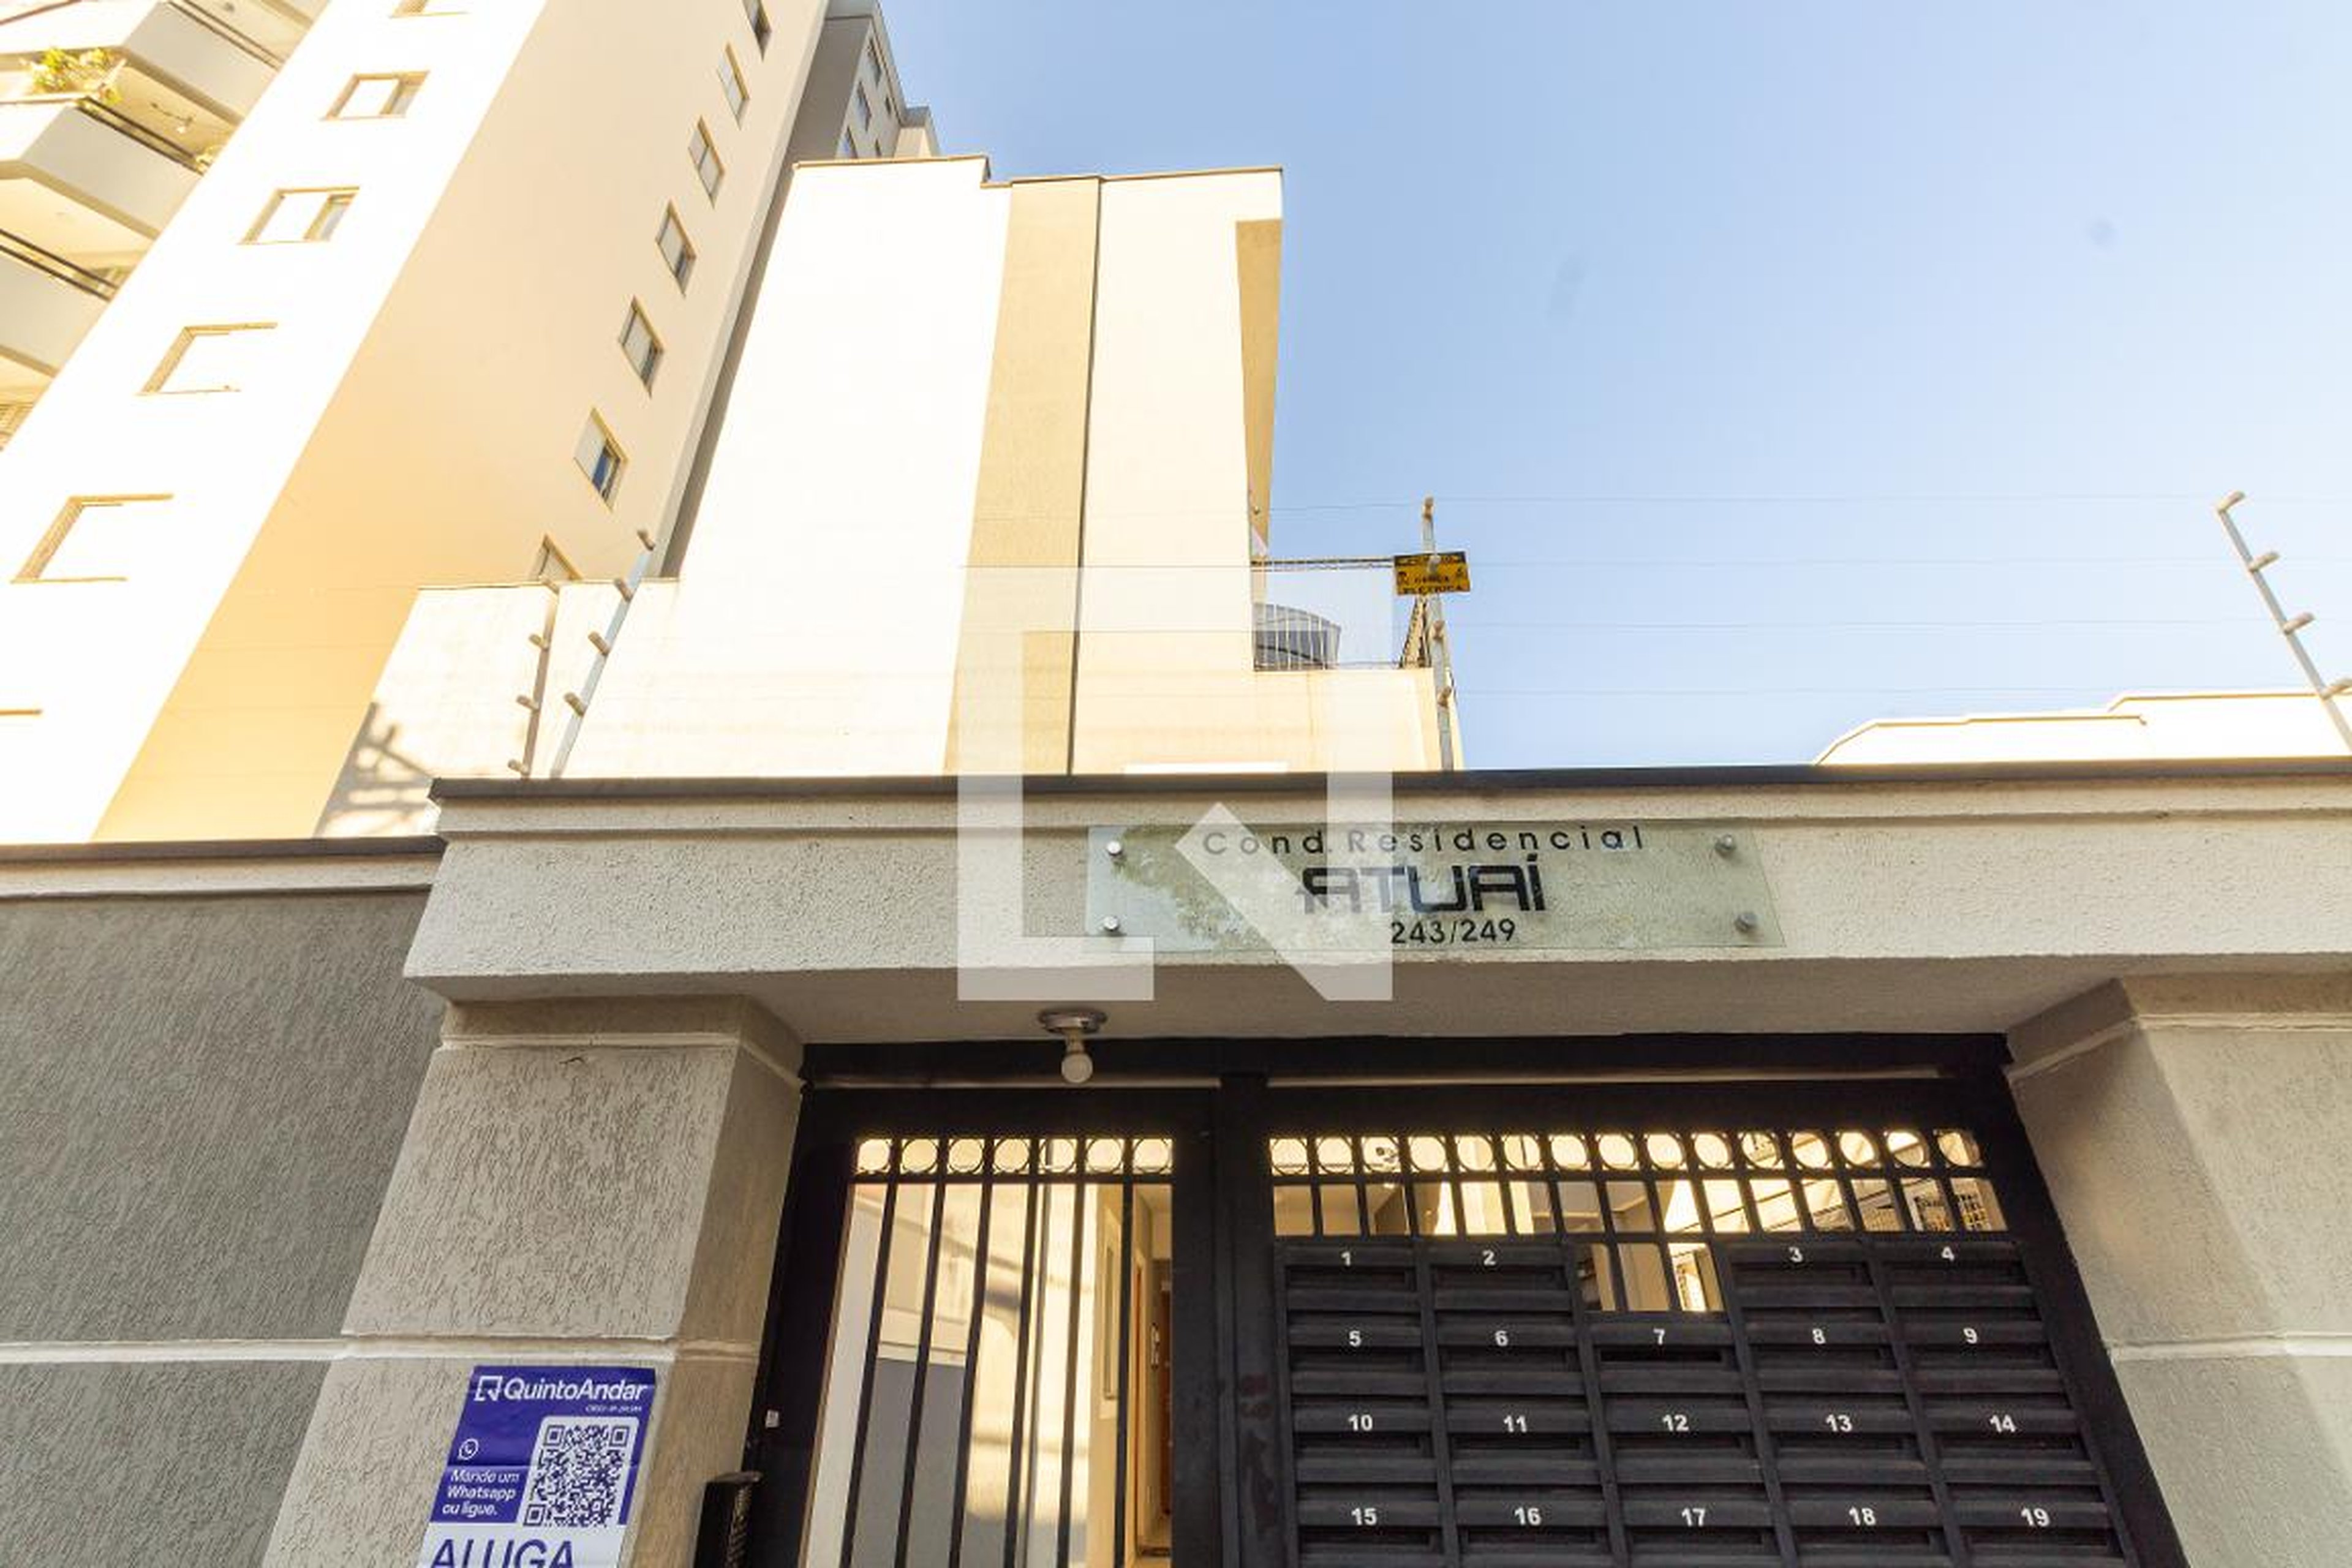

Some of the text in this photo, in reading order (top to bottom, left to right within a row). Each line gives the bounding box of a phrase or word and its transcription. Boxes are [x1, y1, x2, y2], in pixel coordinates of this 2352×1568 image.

[1348, 825, 1644, 853] Residencial
[1390, 919, 1516, 944] 243/249
[1341, 1251, 1351, 1266] 1
[1482, 1249, 1496, 1266] 2
[1789, 1246, 1803, 1263] 3
[1941, 1246, 1955, 1261] 4
[1349, 1330, 1362, 1348] 5
[1494, 1330, 1509, 1347] 6
[1653, 1327, 1666, 1345] 7
[1811, 1327, 1826, 1345] 8
[1962, 1327, 1978, 1344] 9
[503, 1378, 648, 1401] QuintoAndar
[1348, 1414, 1373, 1431] 10
[1502, 1414, 1528, 1433] 11
[1662, 1414, 1690, 1432] 12
[1825, 1413, 1853, 1433] 13
[1989, 1414, 2017, 1433] 14
[1351, 1507, 1378, 1526] 15
[1513, 1506, 1542, 1526] 16
[1681, 1507, 1706, 1527] 17
[1848, 1506, 1877, 1526] 18
[2020, 1507, 2051, 1528] 19
